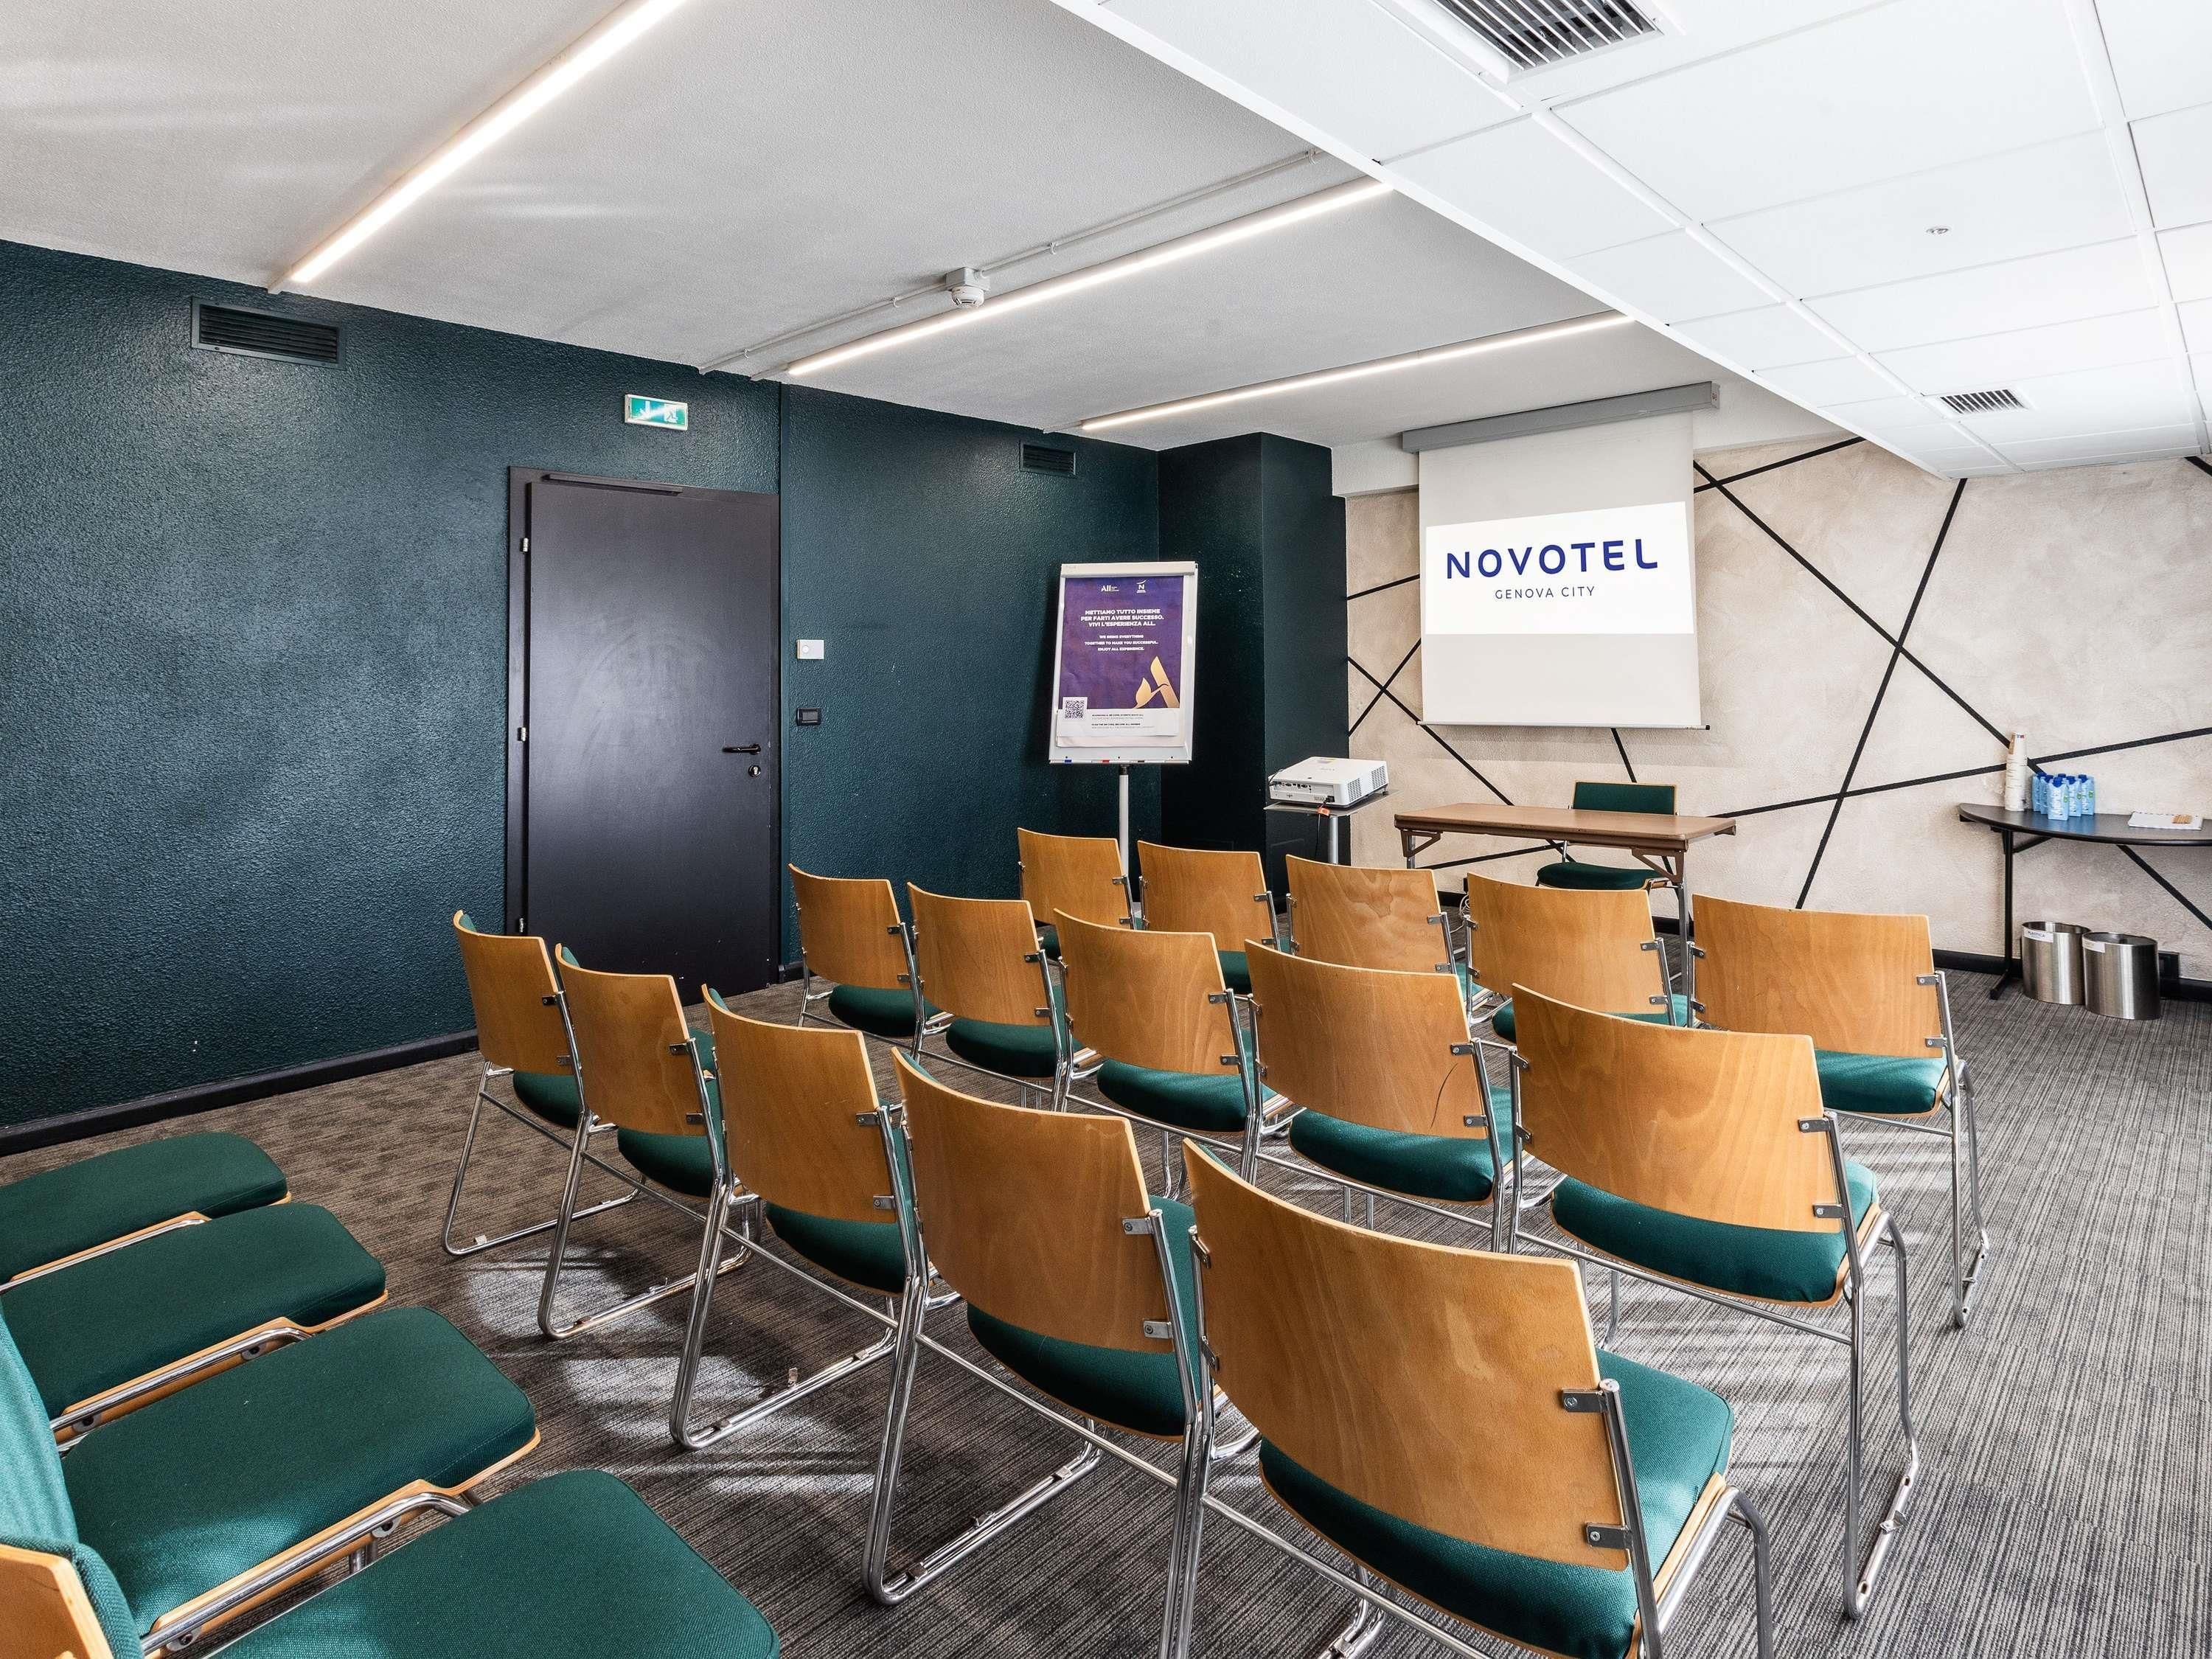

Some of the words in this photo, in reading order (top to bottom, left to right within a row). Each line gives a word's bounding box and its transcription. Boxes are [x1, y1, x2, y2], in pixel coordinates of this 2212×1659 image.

[1447, 538, 1658, 580] NOVOTEL
[1495, 587, 1554, 600] GENOVA
[1561, 585, 1596, 597] CITY
